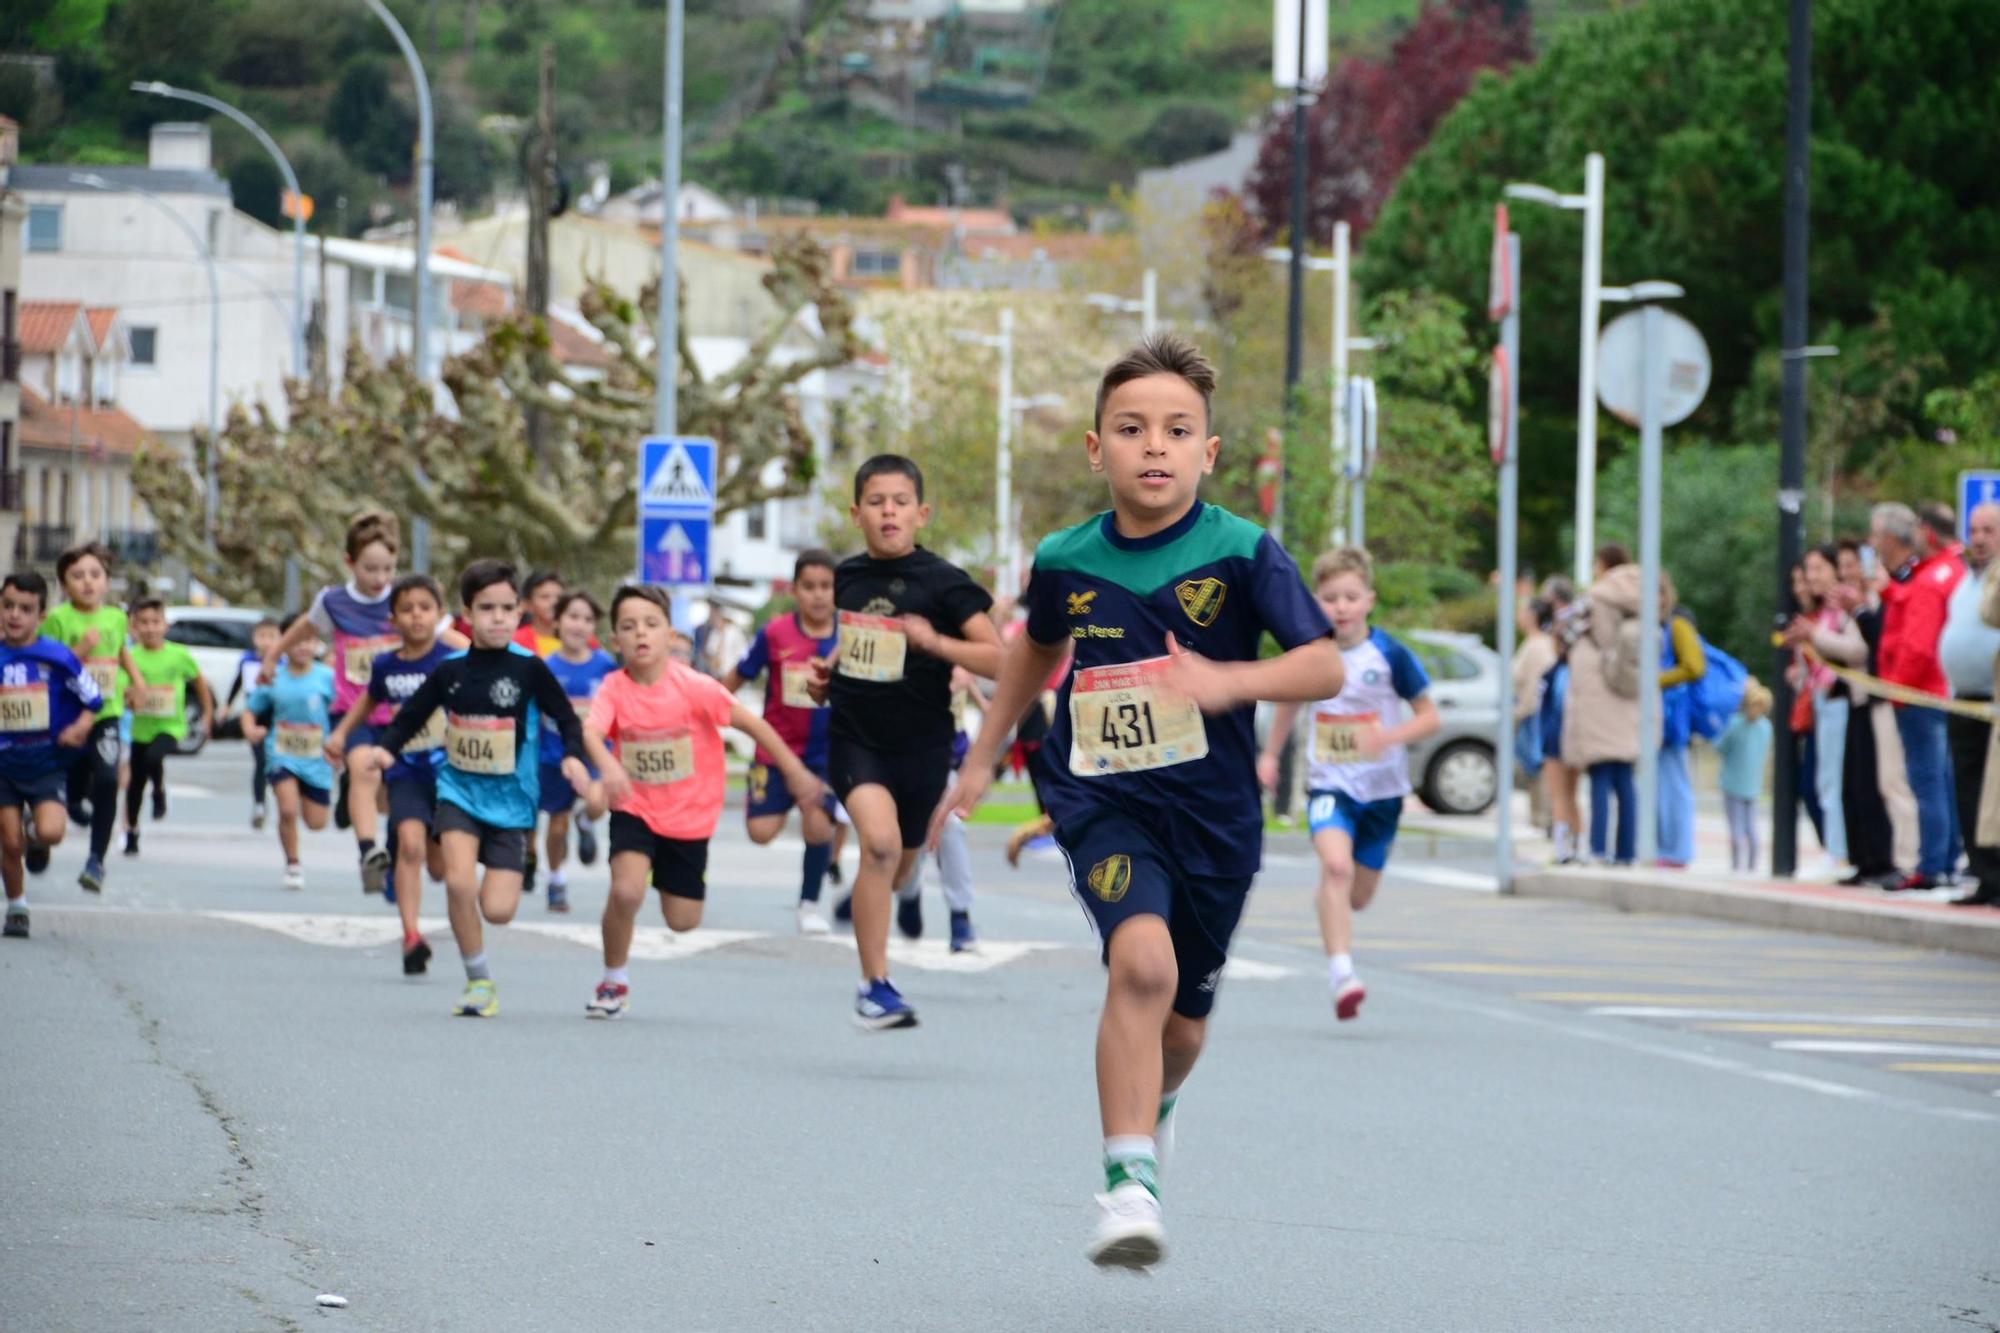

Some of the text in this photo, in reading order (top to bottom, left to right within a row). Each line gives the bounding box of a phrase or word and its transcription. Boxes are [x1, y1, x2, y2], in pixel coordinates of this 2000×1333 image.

[849, 636, 876, 665] 411
[1, 699, 32, 721] 550
[1101, 700, 1158, 750] 431
[456, 738, 494, 762] 404
[635, 749, 675, 773] 556
